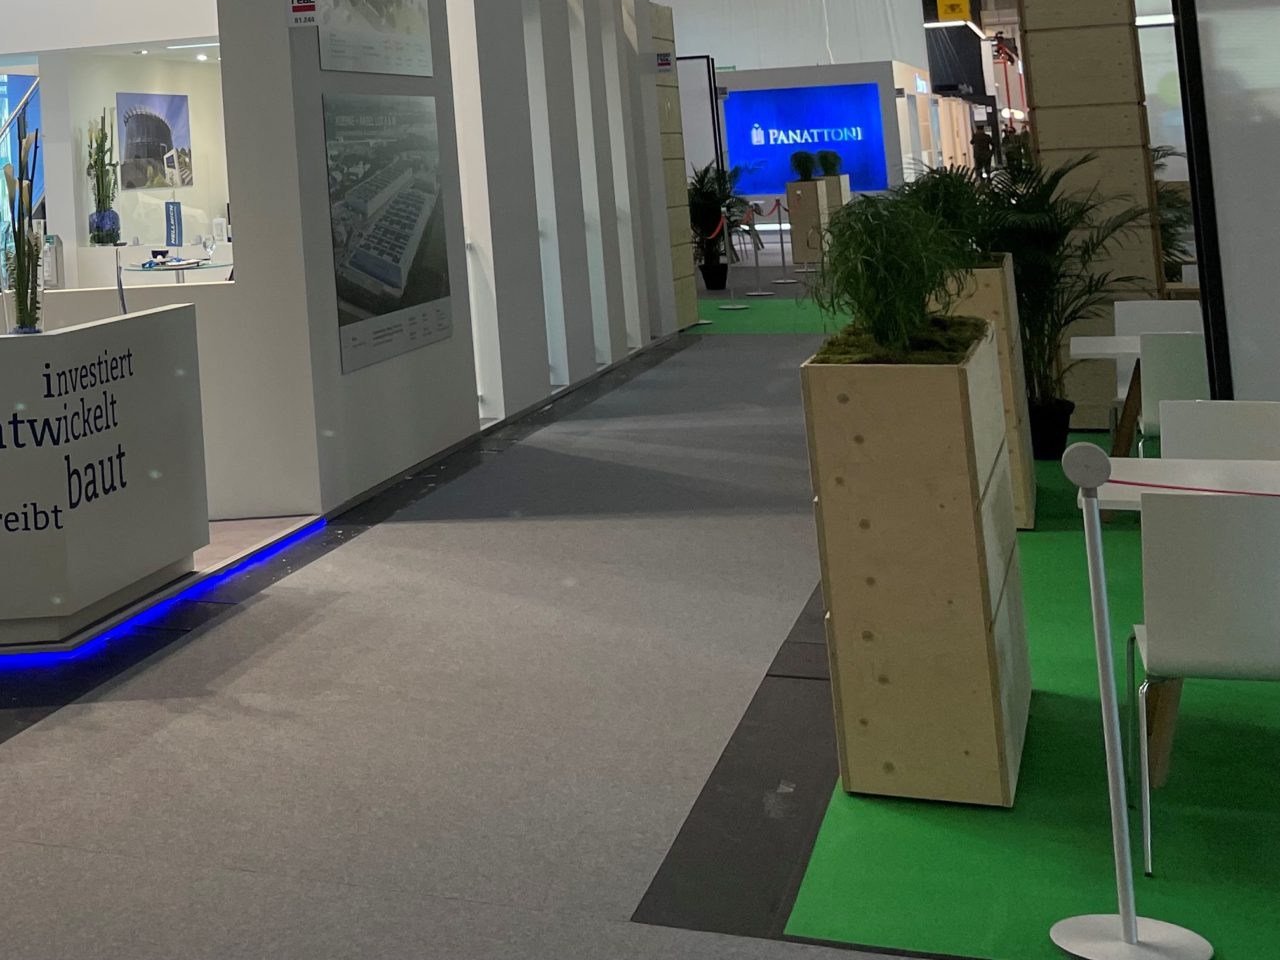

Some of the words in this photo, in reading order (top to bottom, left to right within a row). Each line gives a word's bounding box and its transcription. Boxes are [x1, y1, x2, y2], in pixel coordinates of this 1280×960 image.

[768, 126, 863, 145] PANATTONI
[41, 347, 134, 399] investiert
[64, 443, 128, 510] baut
